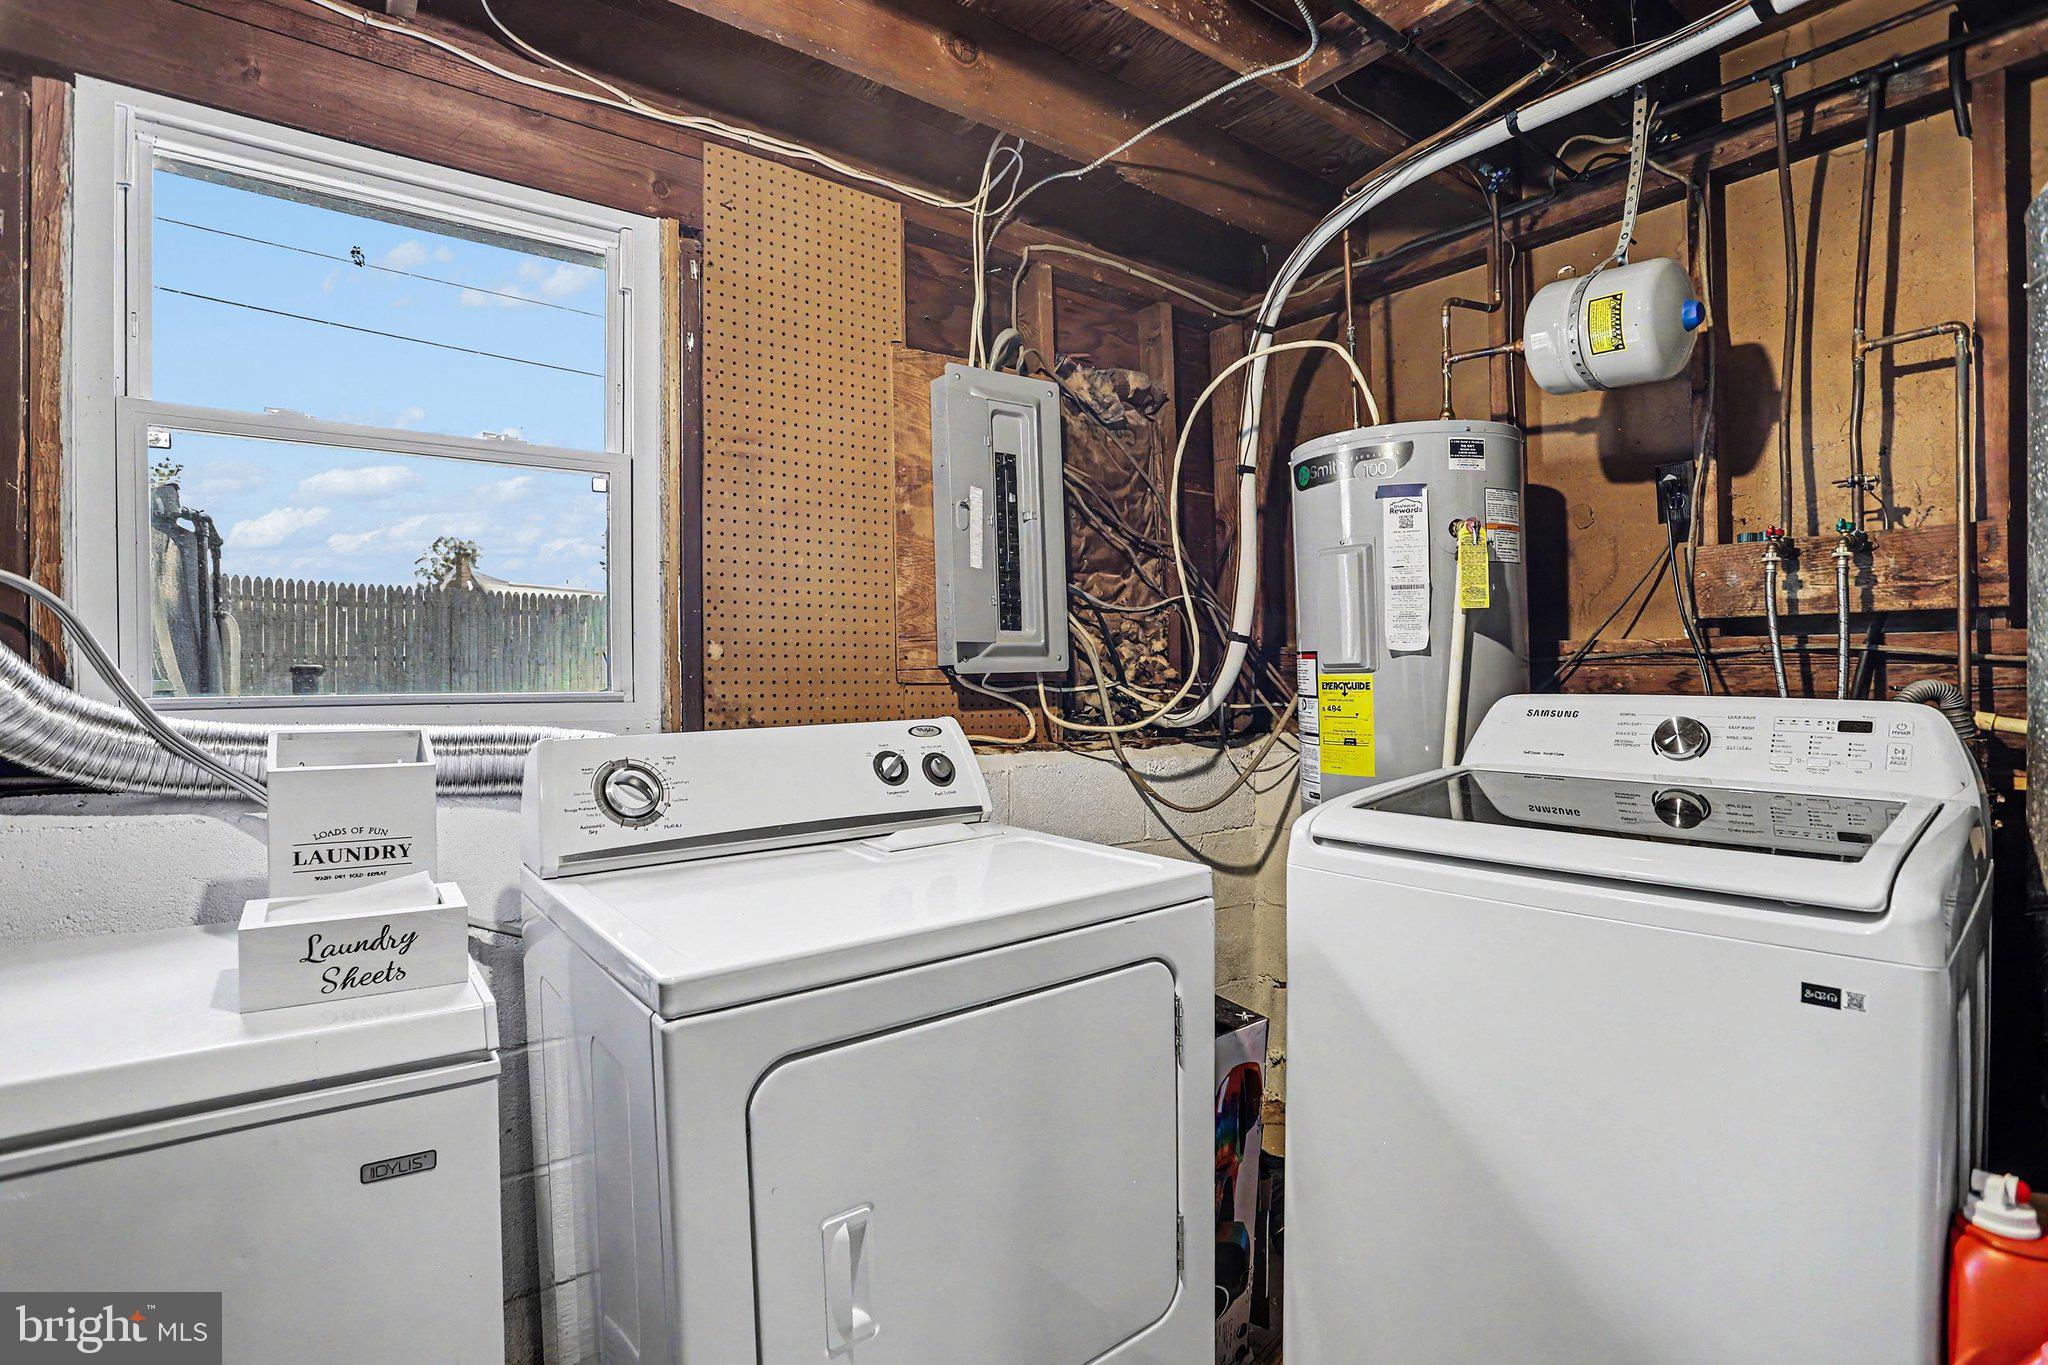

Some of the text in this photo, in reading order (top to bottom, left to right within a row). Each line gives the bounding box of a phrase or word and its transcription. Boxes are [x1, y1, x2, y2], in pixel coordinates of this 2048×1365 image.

[1310, 459, 1346, 479] Smith
[1363, 461, 1387, 478] 100
[1389, 506, 1423, 515] Rewards
[1526, 708, 1580, 719] SAMSUNG
[313, 828, 347, 840] LOADS
[369, 827, 389, 836] FUN
[292, 843, 412, 866] LAUNDRY
[299, 924, 419, 964] Laundry
[321, 960, 407, 995] Sheets
[370, 1156, 424, 1179] IDYLIS
